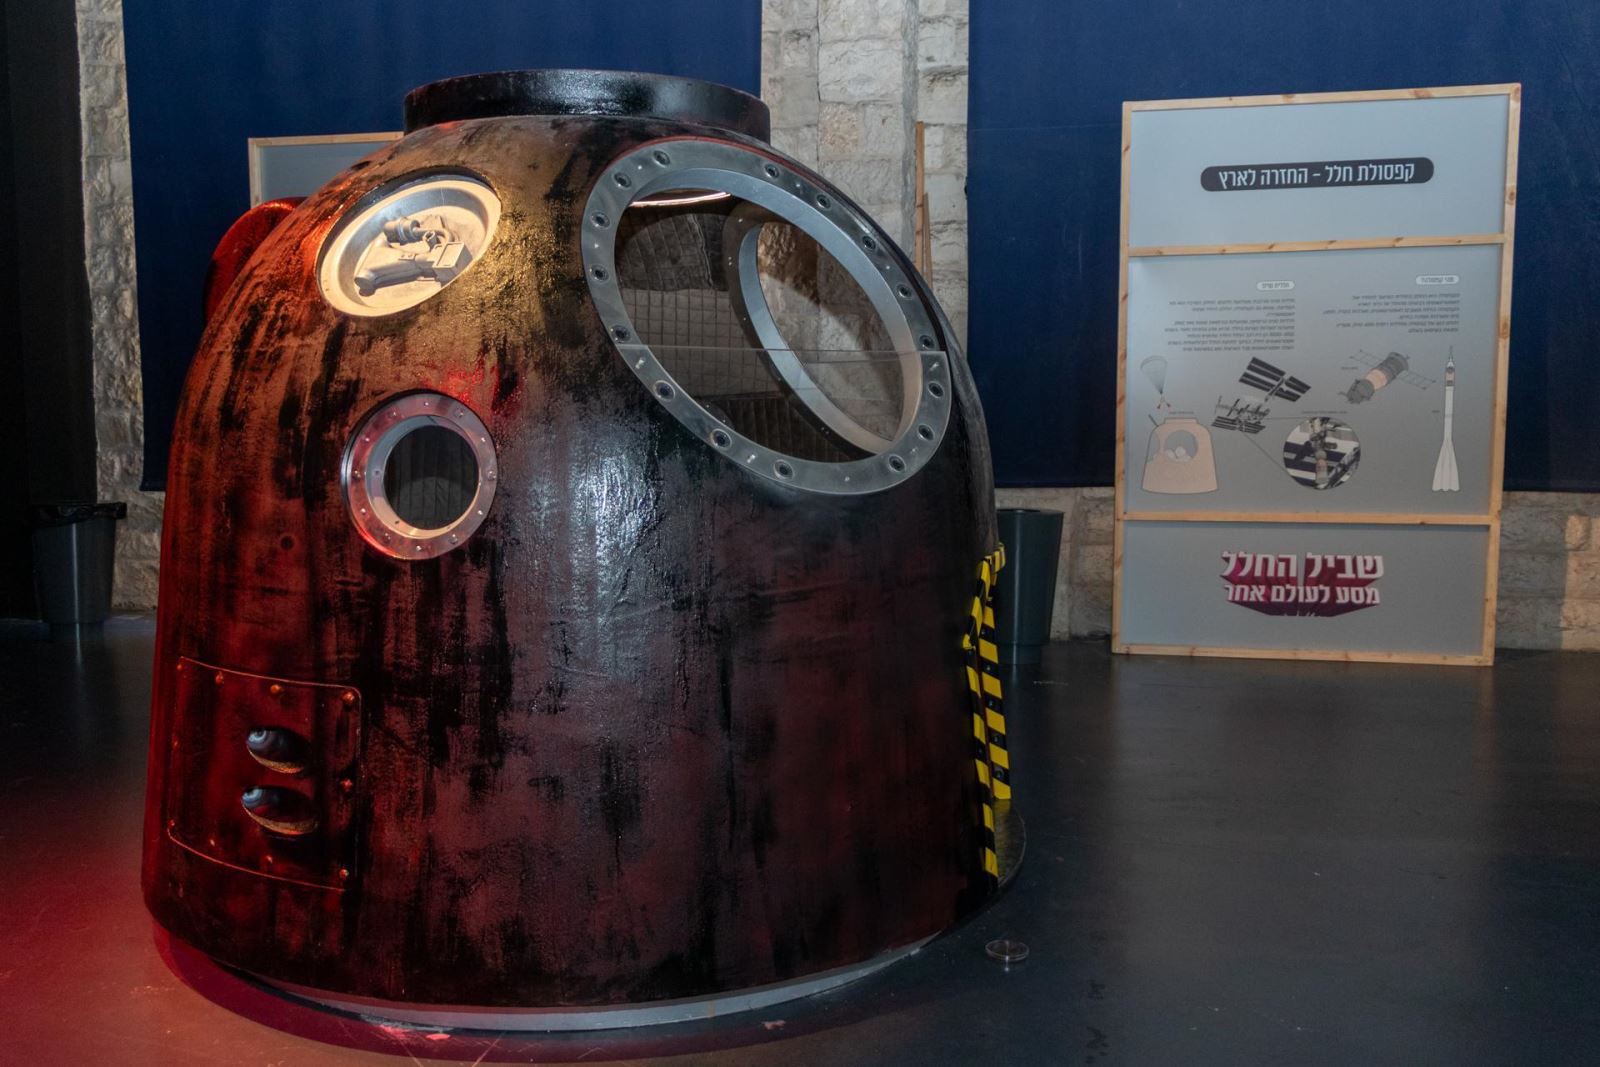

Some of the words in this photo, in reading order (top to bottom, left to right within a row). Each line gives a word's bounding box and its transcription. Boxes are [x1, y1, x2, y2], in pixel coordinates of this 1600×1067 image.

[1218, 168, 1256, 189] לארץ
[1260, 167, 1309, 185] החזרה
[1325, 164, 1353, 183] חלל
[1357, 162, 1415, 182] קפסולת
[1221, 551, 1297, 577] החלל
[1305, 552, 1384, 579] שביל
[1224, 584, 1266, 602] אחר
[1270, 584, 1330, 603] לעולם
[1335, 586, 1381, 604] מסע
